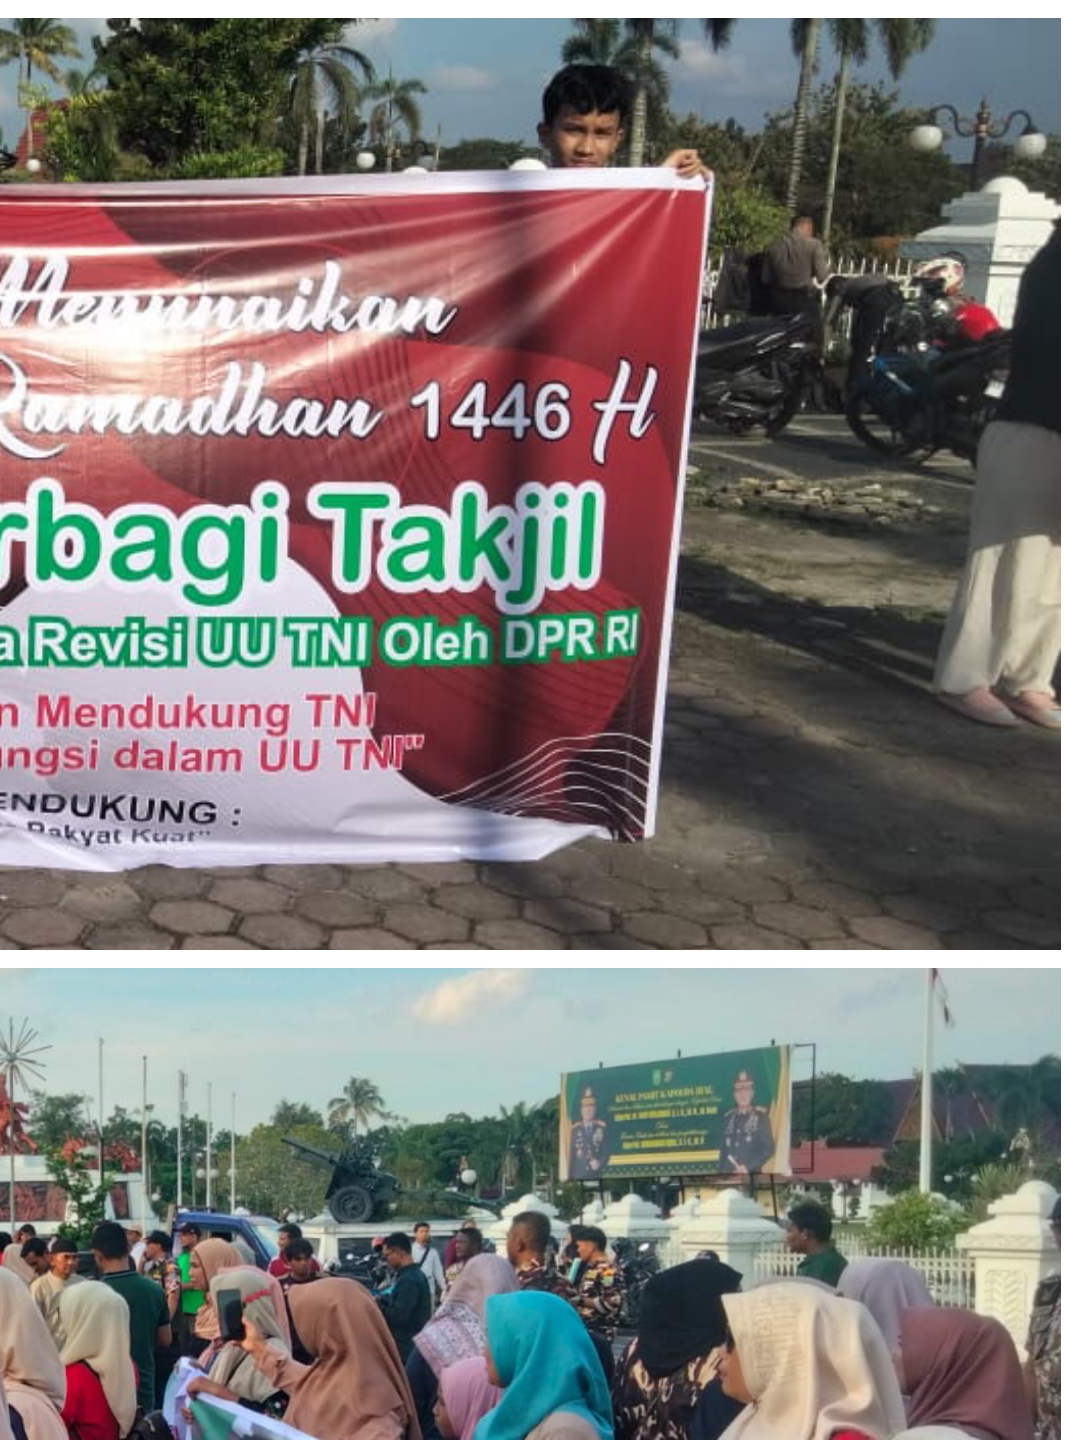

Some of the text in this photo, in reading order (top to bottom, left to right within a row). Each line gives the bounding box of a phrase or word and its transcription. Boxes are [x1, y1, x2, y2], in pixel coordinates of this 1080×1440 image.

[409, 380, 573, 443] 1446
[591, 358, 660, 466] H
[314, 484, 601, 609] Takjil
[34, 620, 184, 663] Revisi
[201, 622, 271, 664] UU
[287, 621, 368, 664] TNI
[383, 621, 490, 663] Oleh
[505, 616, 594, 661] DPR
[606, 612, 638, 656] RI
[36, 694, 291, 735] Mendukung
[306, 693, 377, 729] TNI
[114, 740, 242, 772] dalam
[260, 740, 319, 772] UU
[336, 733, 425, 772] TNI"
[232, 807, 241, 826] :
